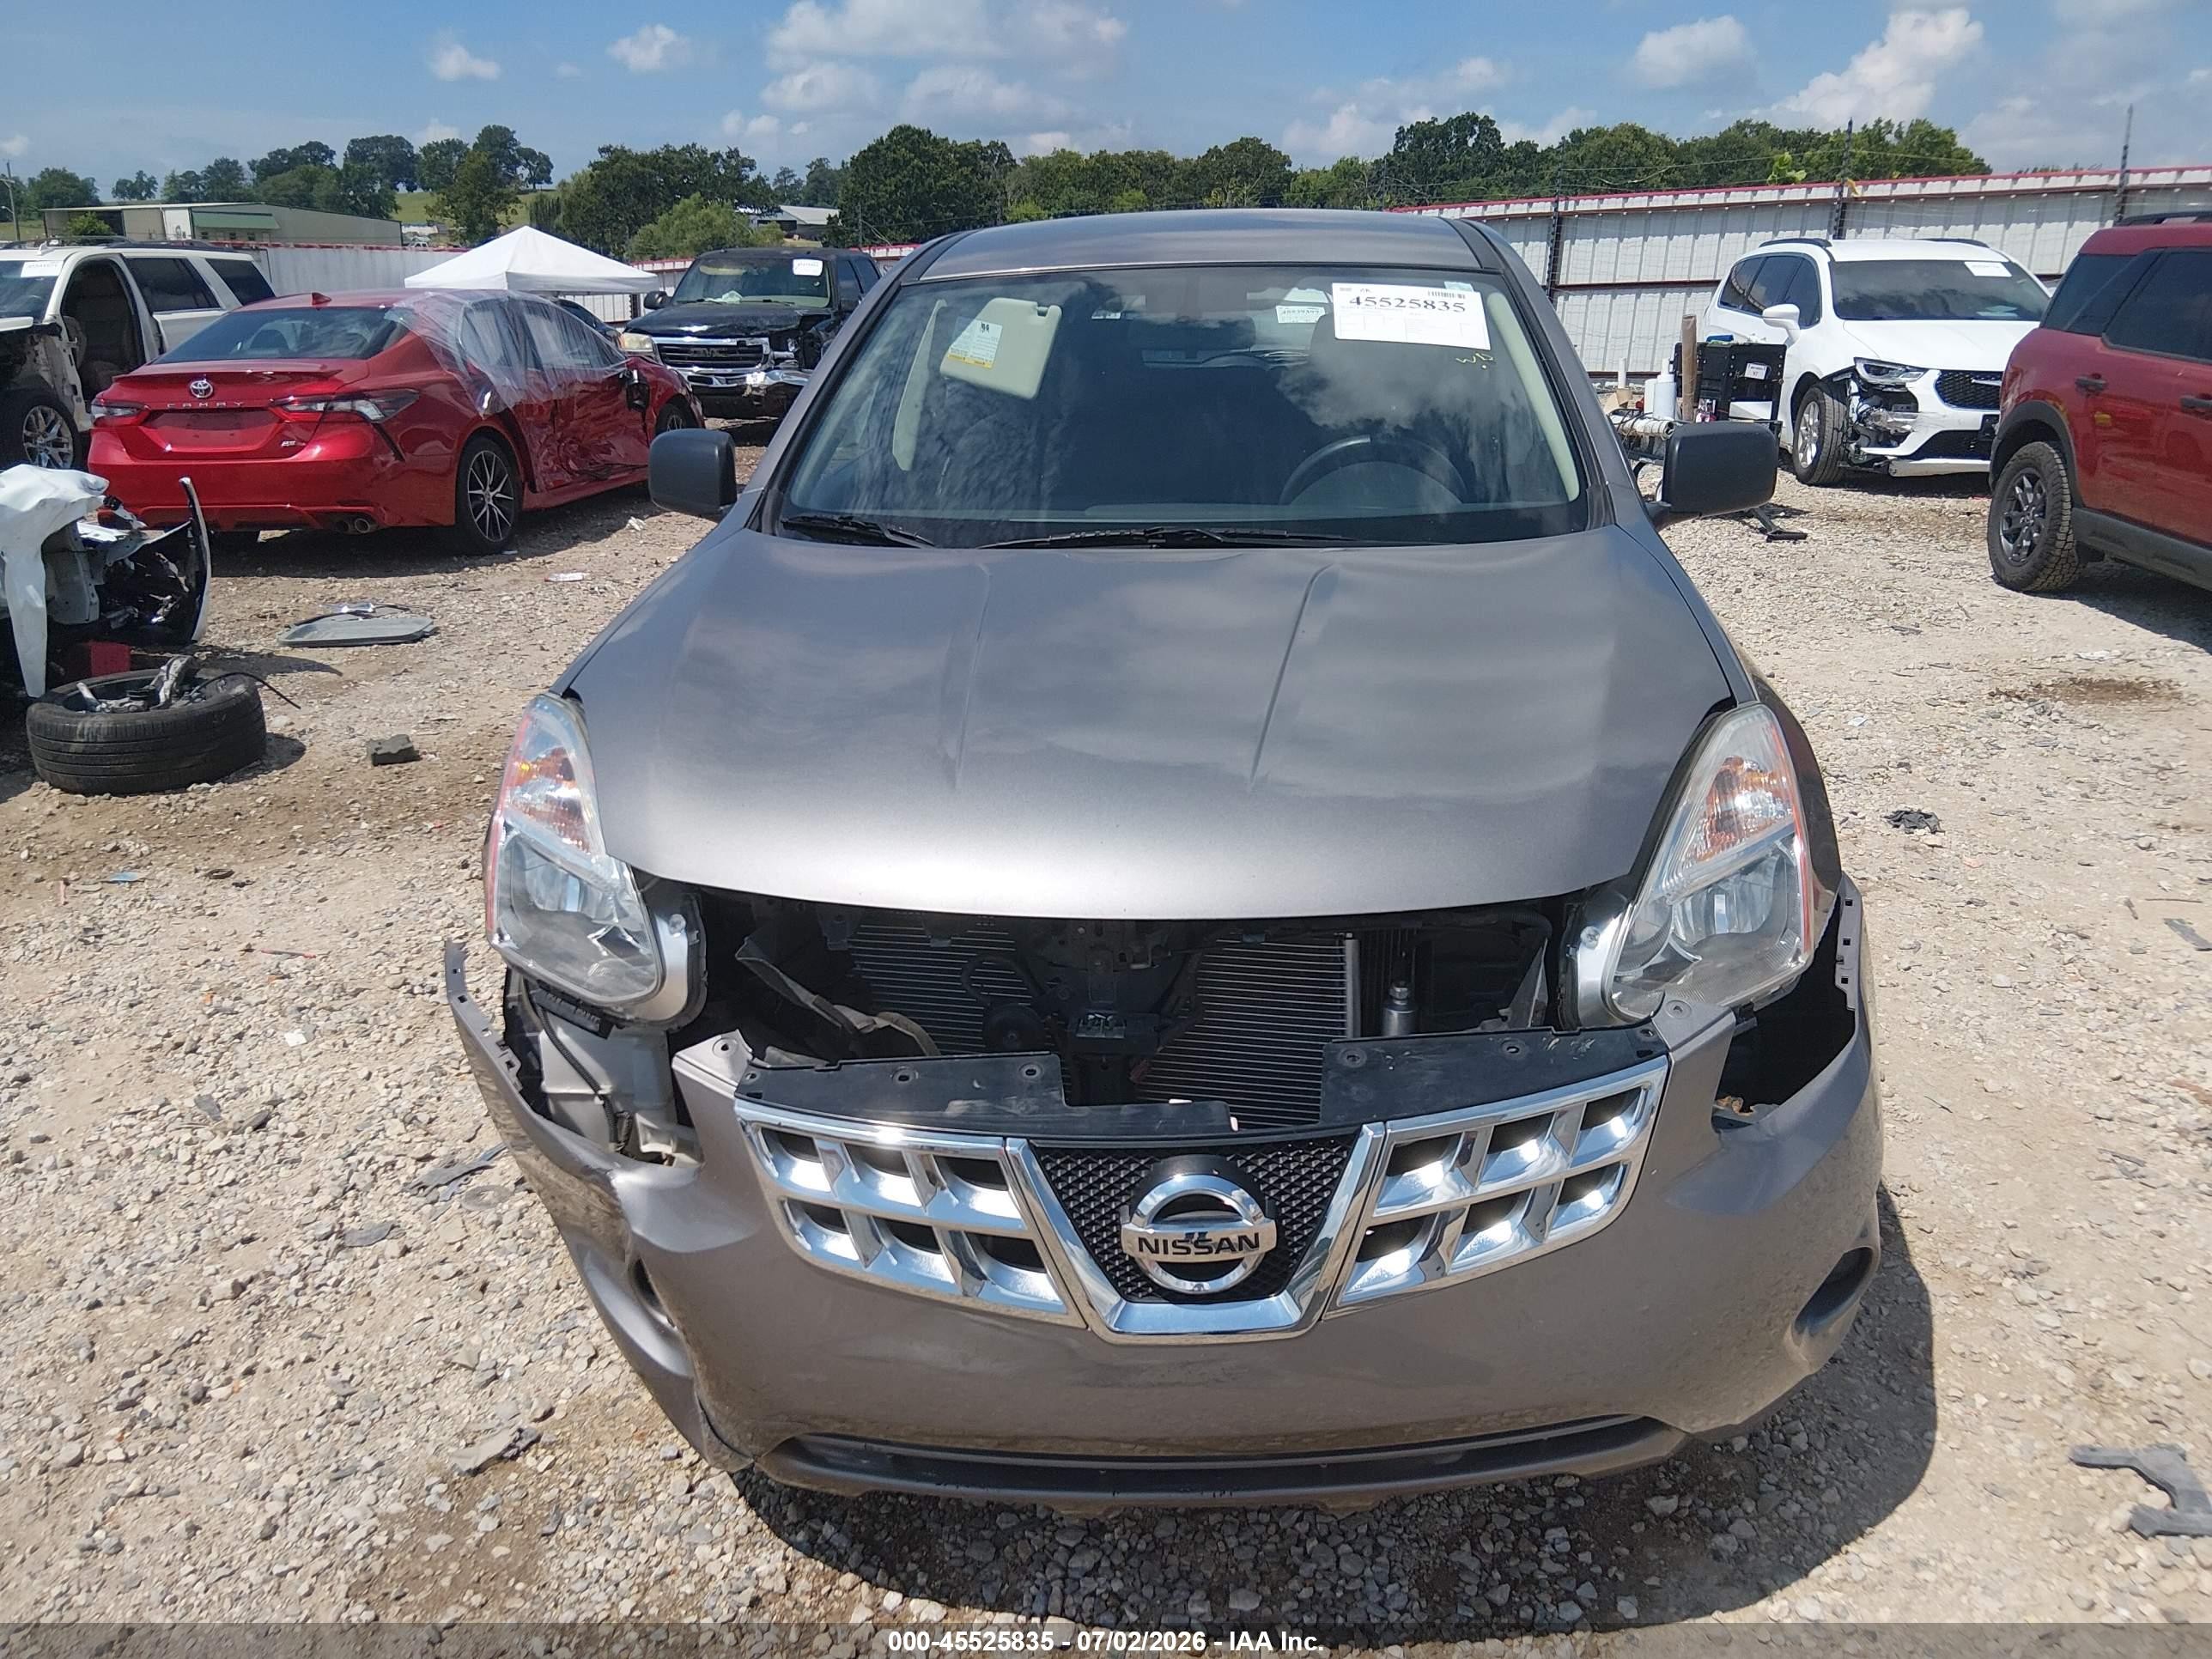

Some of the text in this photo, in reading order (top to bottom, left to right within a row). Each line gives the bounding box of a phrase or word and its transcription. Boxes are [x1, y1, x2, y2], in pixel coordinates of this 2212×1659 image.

[1349, 295, 1467, 313] 45525835
[167, 401, 244, 410] CAMRY
[1138, 1232, 1260, 1255] NISSAN
